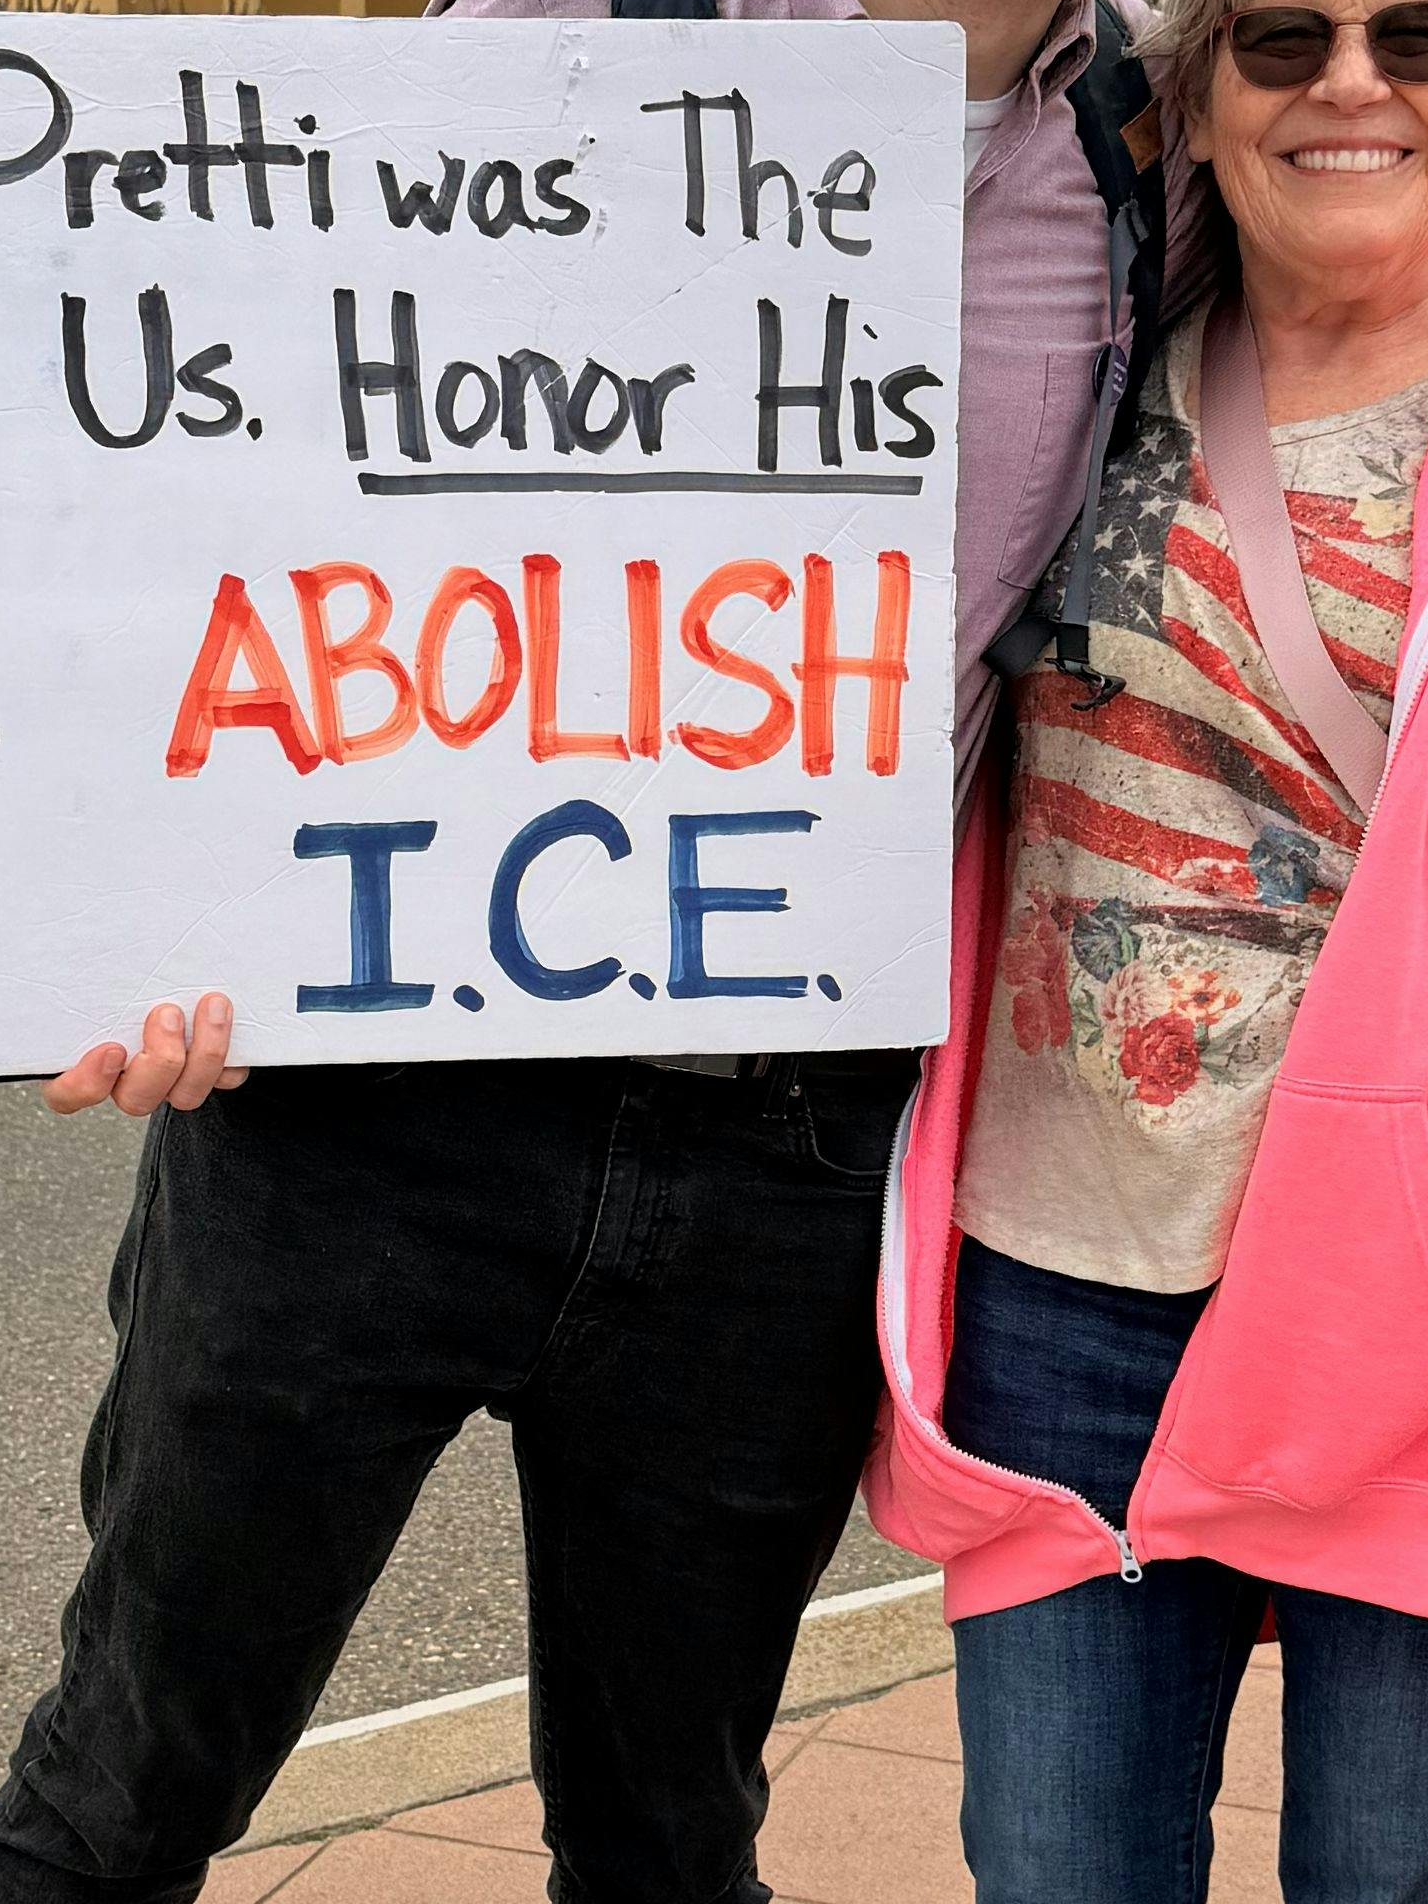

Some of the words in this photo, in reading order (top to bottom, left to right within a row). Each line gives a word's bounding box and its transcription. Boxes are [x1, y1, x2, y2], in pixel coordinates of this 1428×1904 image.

[376, 150, 590, 239] was
[639, 88, 876, 256] The
[60, 282, 263, 449] Us.
[332, 288, 696, 463] Honor
[755, 292, 944, 473] His
[166, 550, 911, 778] ABOLISH
[293, 799, 842, 1013] I.C.E.
